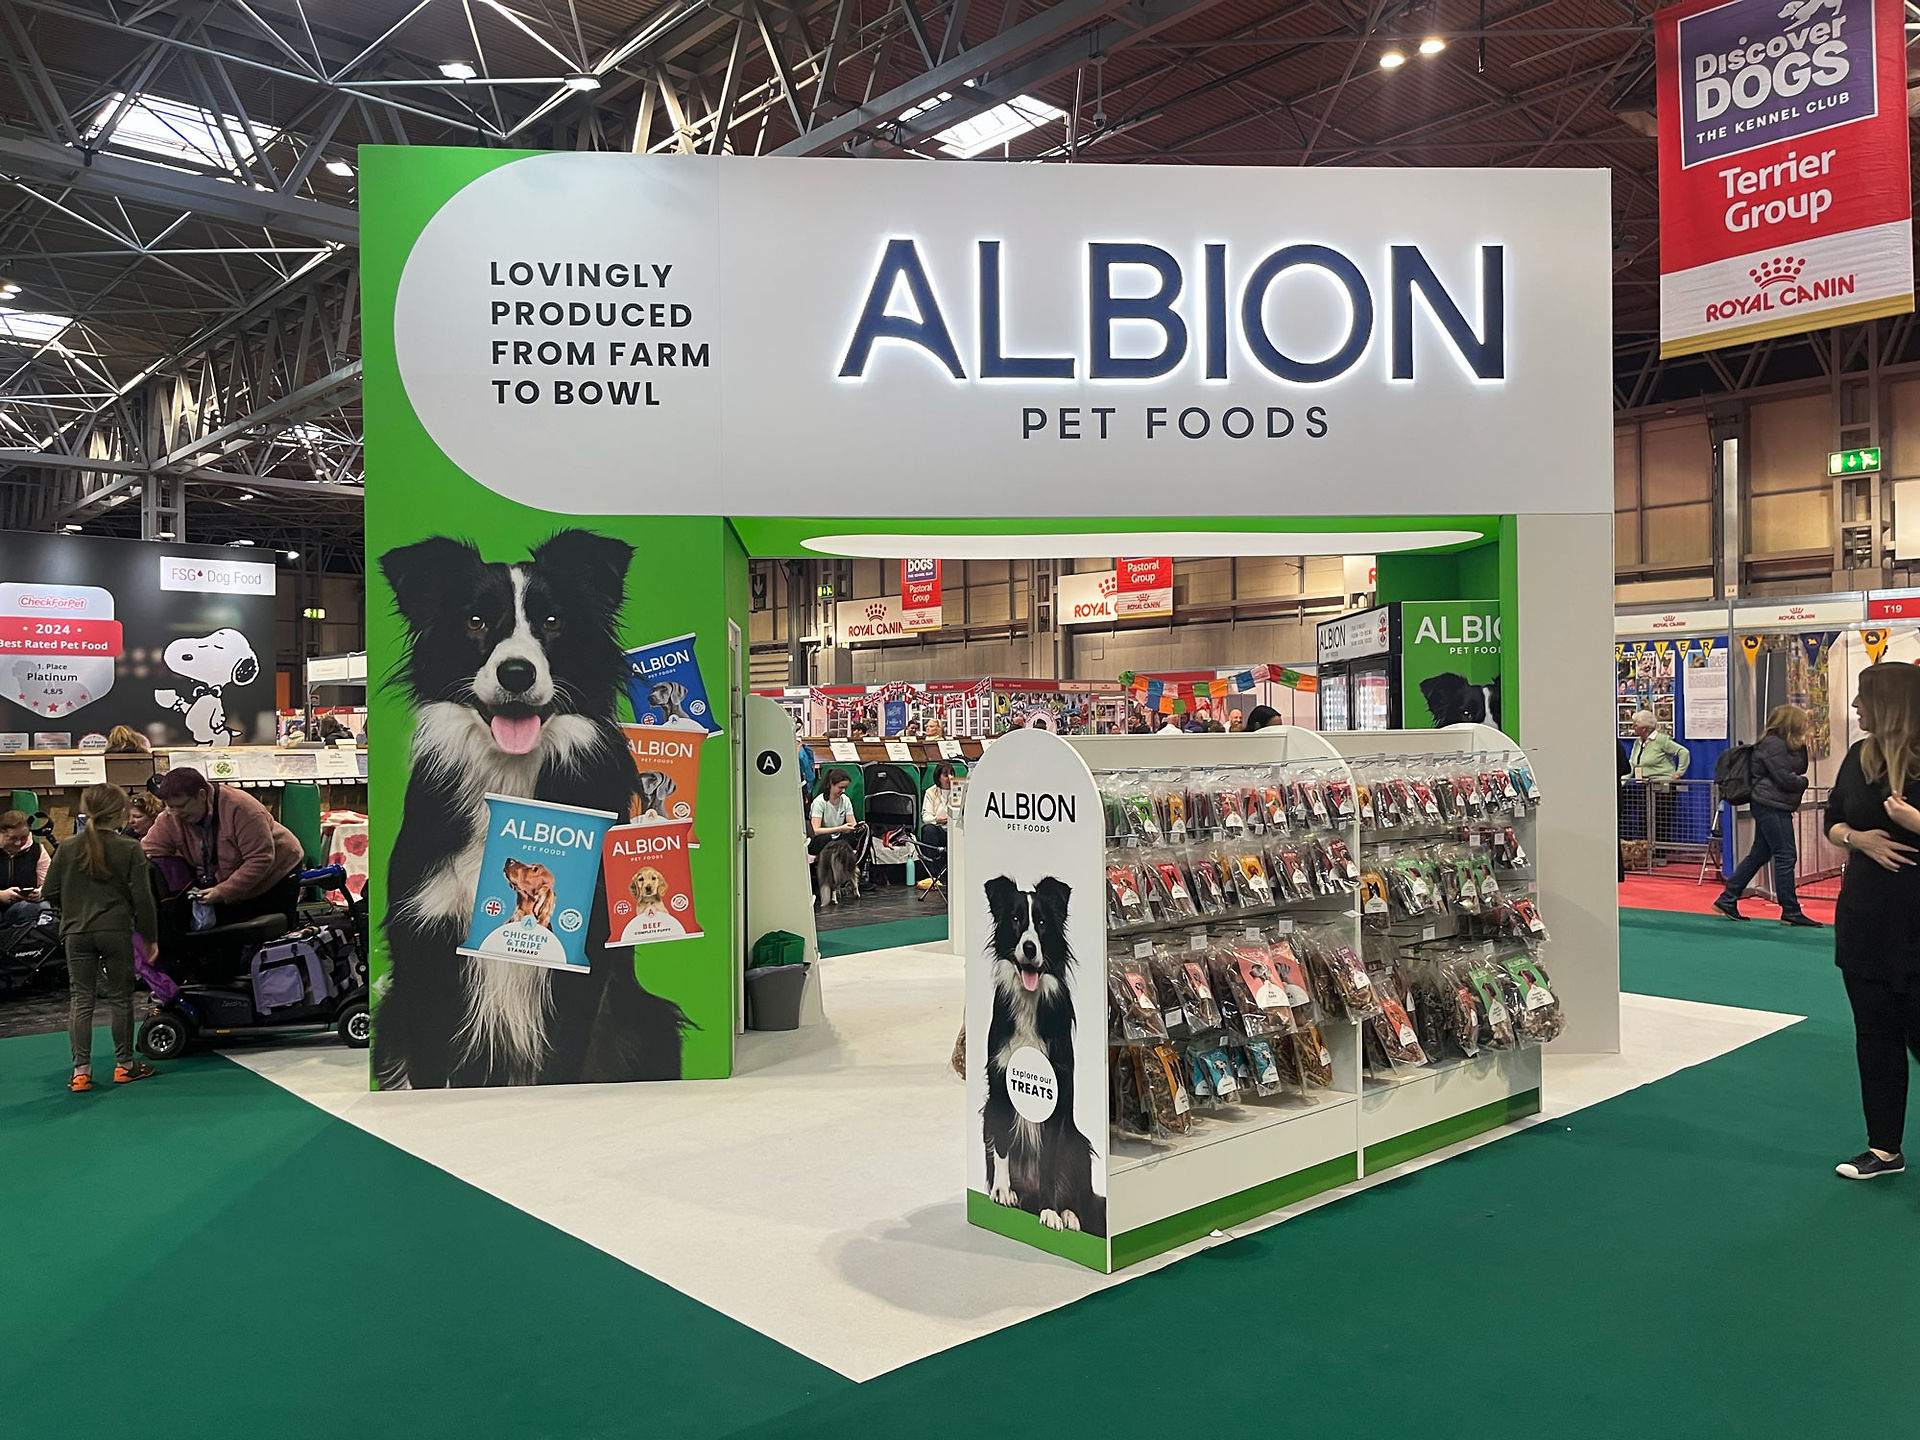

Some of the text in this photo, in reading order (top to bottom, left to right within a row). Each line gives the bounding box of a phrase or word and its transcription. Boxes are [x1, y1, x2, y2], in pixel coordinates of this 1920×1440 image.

[1695, 15, 1847, 82] Discover
[1696, 40, 1850, 122] DOGS
[1696, 92, 1850, 144] THE KENNEL CLUB
[1719, 149, 1836, 199] Terrier
[1725, 188, 1832, 232] Group
[490, 262, 673, 288] LOVINGLY
[1706, 274, 1855, 322] ROYAL CANIN
[491, 301, 693, 328] PRODUCED
[838, 238, 1505, 381] ALBION
[492, 341, 709, 367] FROM FARM
[491, 380, 660, 406] TO BOWL
[1022, 406, 1328, 440] PET FOODS
[1127, 560, 1160, 573] Pastoral
[172, 567, 262, 585] FSG Dog Food
[1131, 573, 1155, 584] Group
[909, 582, 932, 593] Pastoral
[20, 596, 86, 609] CheckForPet
[912, 594, 930, 603] Group
[1143, 601, 1160, 609] CANIN
[1074, 601, 1111, 618] ROYAL
[1883, 604, 1903, 614] T19
[35, 624, 71, 635] 2024
[848, 623, 875, 637] ROYAL
[1320, 624, 1346, 651] ALBION
[25, 640, 57, 649] Rated
[61, 641, 79, 650] Pet
[82, 641, 108, 650] Food
[1450, 646, 1501, 654] PET FOO
[631, 649, 690, 676] ALBION
[27, 672, 78, 682] Platinum
[628, 739, 693, 758] ALBION
[763, 756, 775, 770] A
[984, 791, 1076, 823] ALBION
[500, 818, 595, 850] ALBION
[1007, 823, 1051, 833] PET FOODS
[522, 844, 566, 857] PET FOODS
[612, 835, 681, 857] ALBION
[524, 918, 533, 927] A
[642, 921, 662, 929] BEEF
[502, 929, 548, 943] CHICKEN
[507, 947, 539, 956] STANDARD
[1012, 1068, 1052, 1084] Explore our
[1010, 1079, 1054, 1101] TREATS
